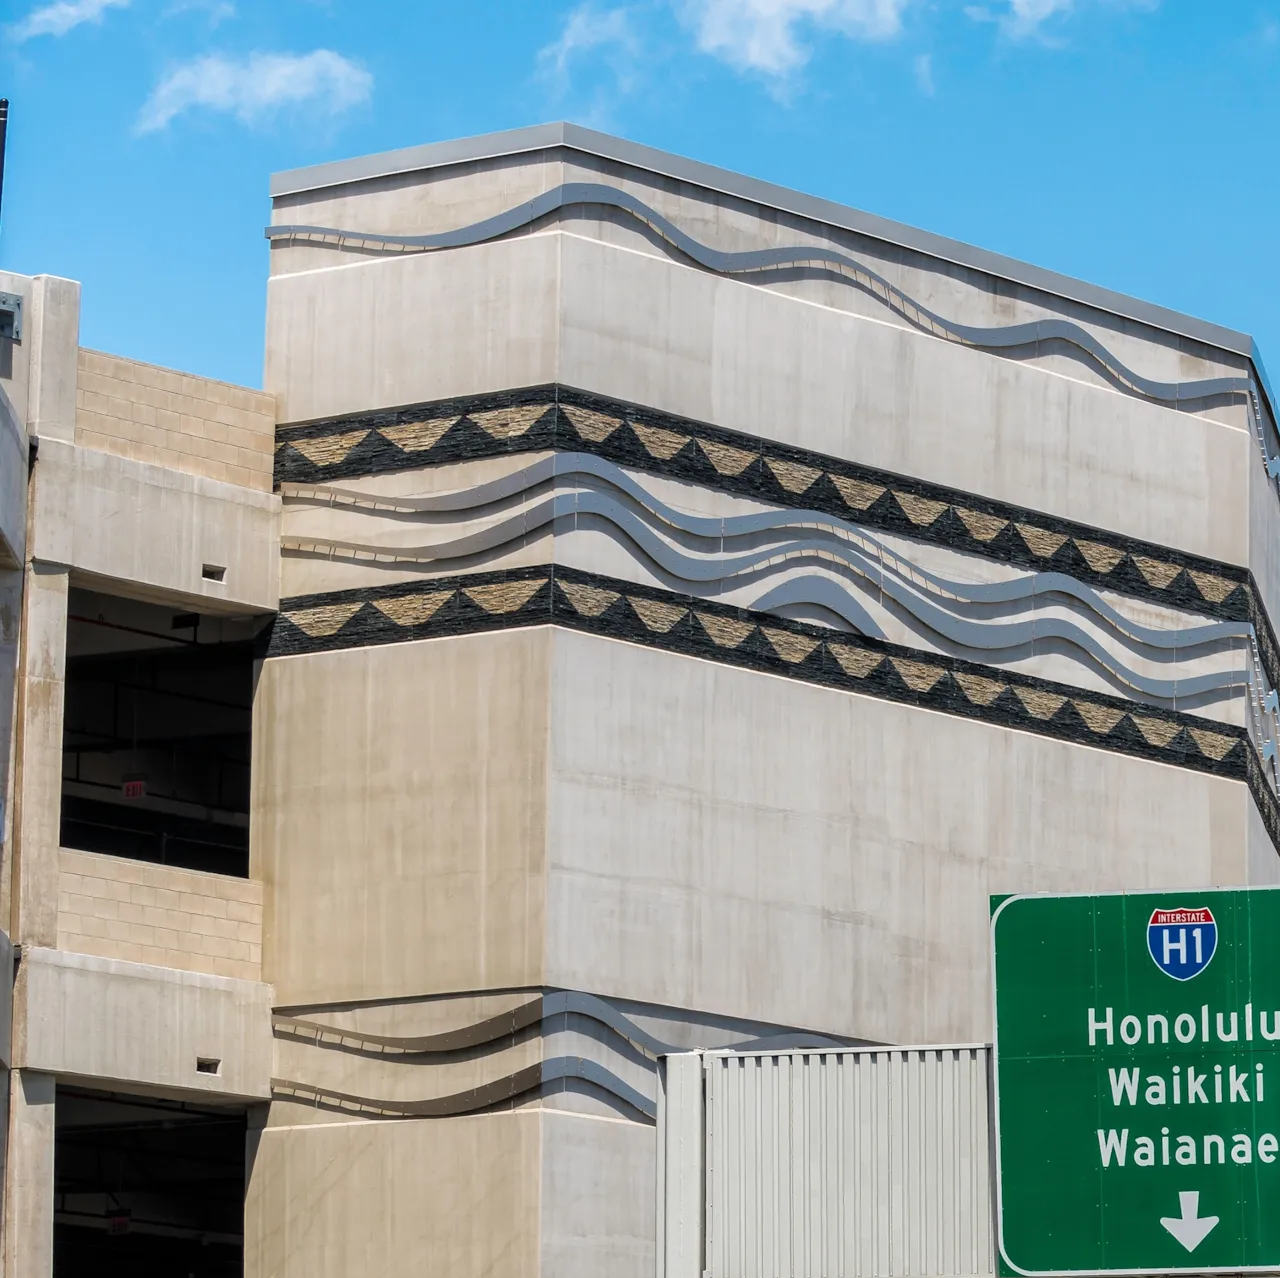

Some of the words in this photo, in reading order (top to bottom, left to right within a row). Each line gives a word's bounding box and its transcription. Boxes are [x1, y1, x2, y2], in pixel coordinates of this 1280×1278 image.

[1157, 911, 1206, 923] INTERSTATE
[1162, 927, 1203, 965] H1
[1108, 1062, 1264, 1106] Waikiki
[1096, 1126, 1279, 1168] Waianae
